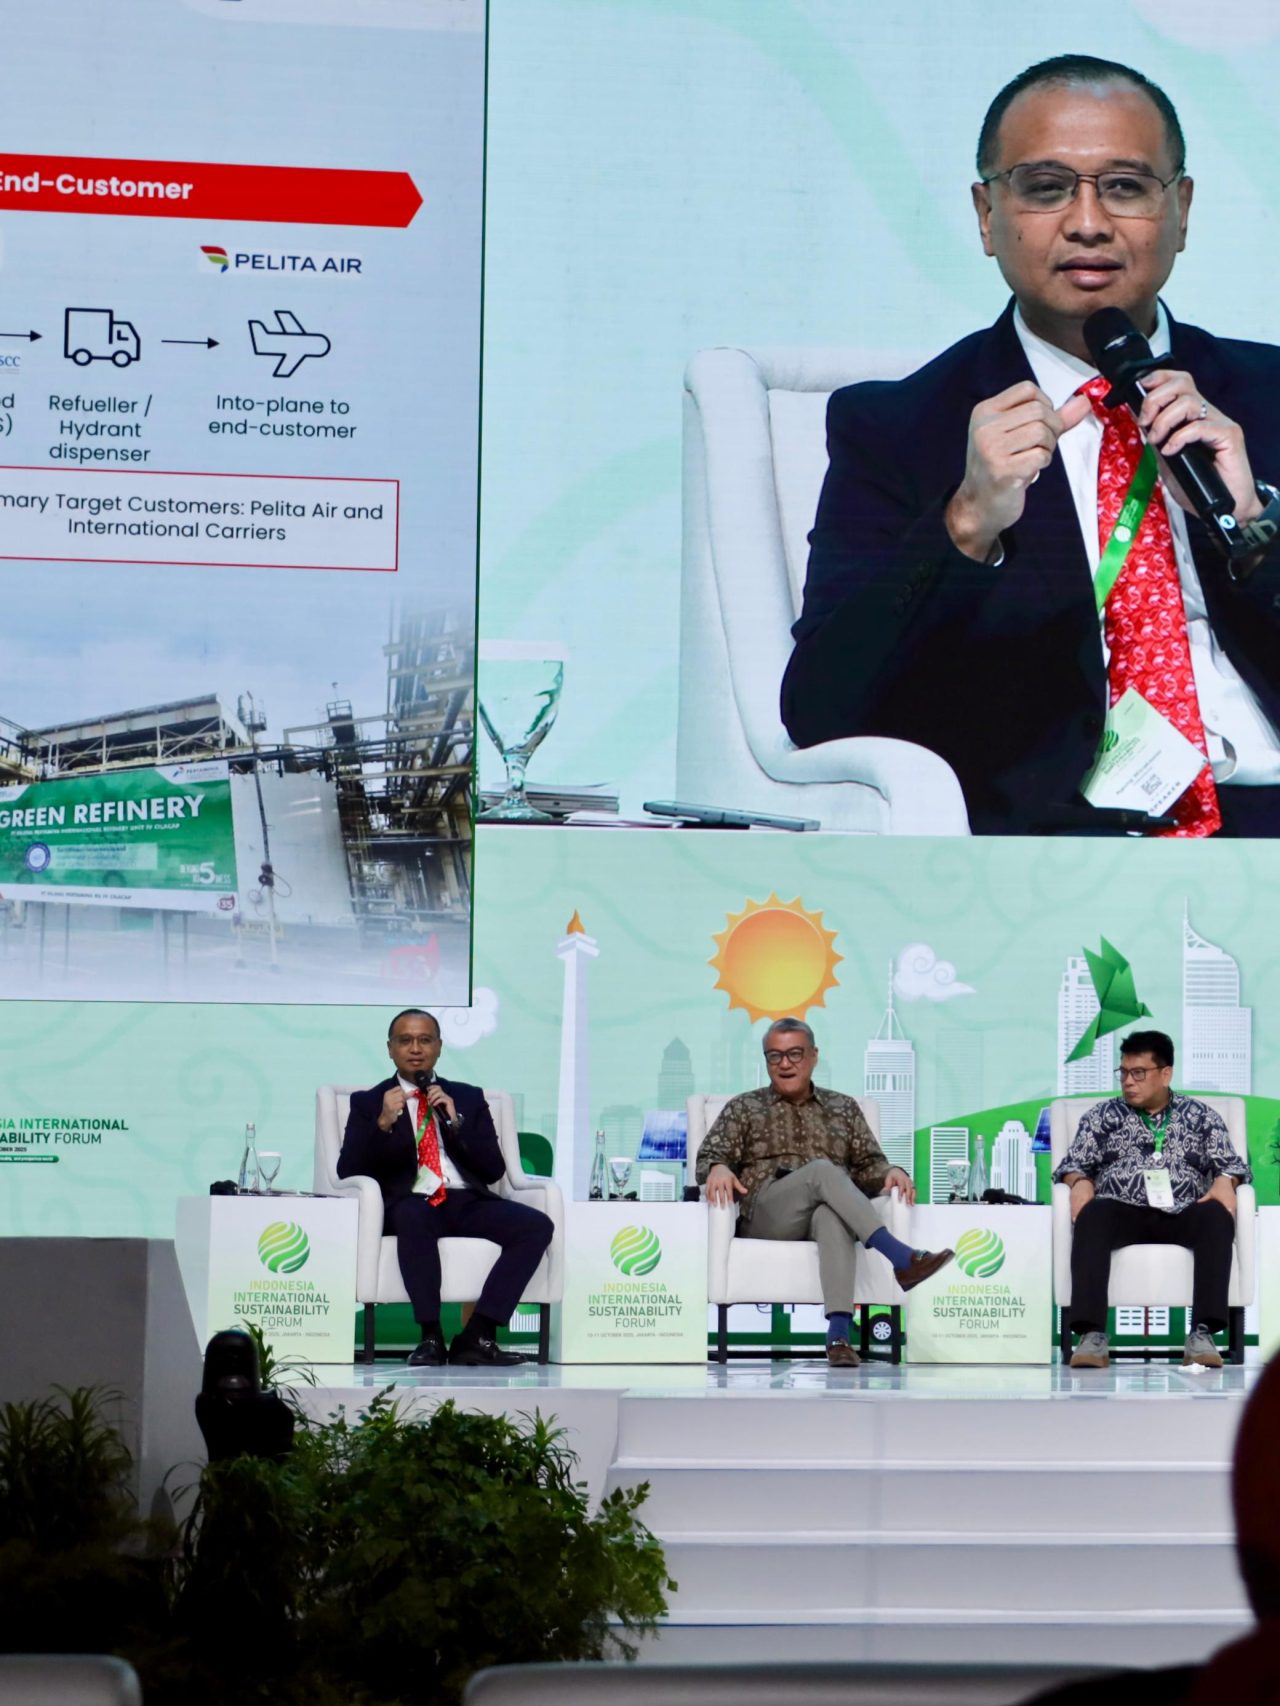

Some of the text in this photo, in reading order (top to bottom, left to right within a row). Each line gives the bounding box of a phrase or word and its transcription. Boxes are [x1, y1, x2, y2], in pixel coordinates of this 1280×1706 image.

[234, 253, 362, 274] PELITA AIR
[48, 394, 152, 417] Refueller /
[216, 394, 350, 416] Into-plane to
[59, 420, 141, 442] Hydrant
[208, 420, 357, 440] end-customer
[49, 444, 151, 464] dispenser
[56, 493, 122, 513] Target
[128, 496, 245, 515] Customers:
[250, 499, 306, 518] Pelita
[311, 502, 338, 518] Air
[343, 503, 383, 520] and
[68, 518, 287, 541] International Carriers
[0, 793, 204, 828] GREEN REFINERY
[20, 1118, 129, 1130] INTERNATIONAL
[54, 1133, 102, 1144] FORUM
[249, 1280, 315, 1291] INDONESIA
[603, 1283, 667, 1293] INDONESIA
[948, 1285, 1011, 1295] INDONESIA
[233, 1292, 330, 1303] INTERNATIONAL
[588, 1294, 683, 1304] INTERNATIONAL
[933, 1296, 1026, 1306] INTERNATIONAL
[234, 1304, 330, 1315] SUSTAINABILITY
[588, 1306, 682, 1316] SUSTAINABILITY
[933, 1307, 1026, 1318] SUSTAINABILITY
[261, 1316, 302, 1327] FORUM
[615, 1318, 656, 1328] FORUM
[959, 1319, 999, 1329] FORUM
